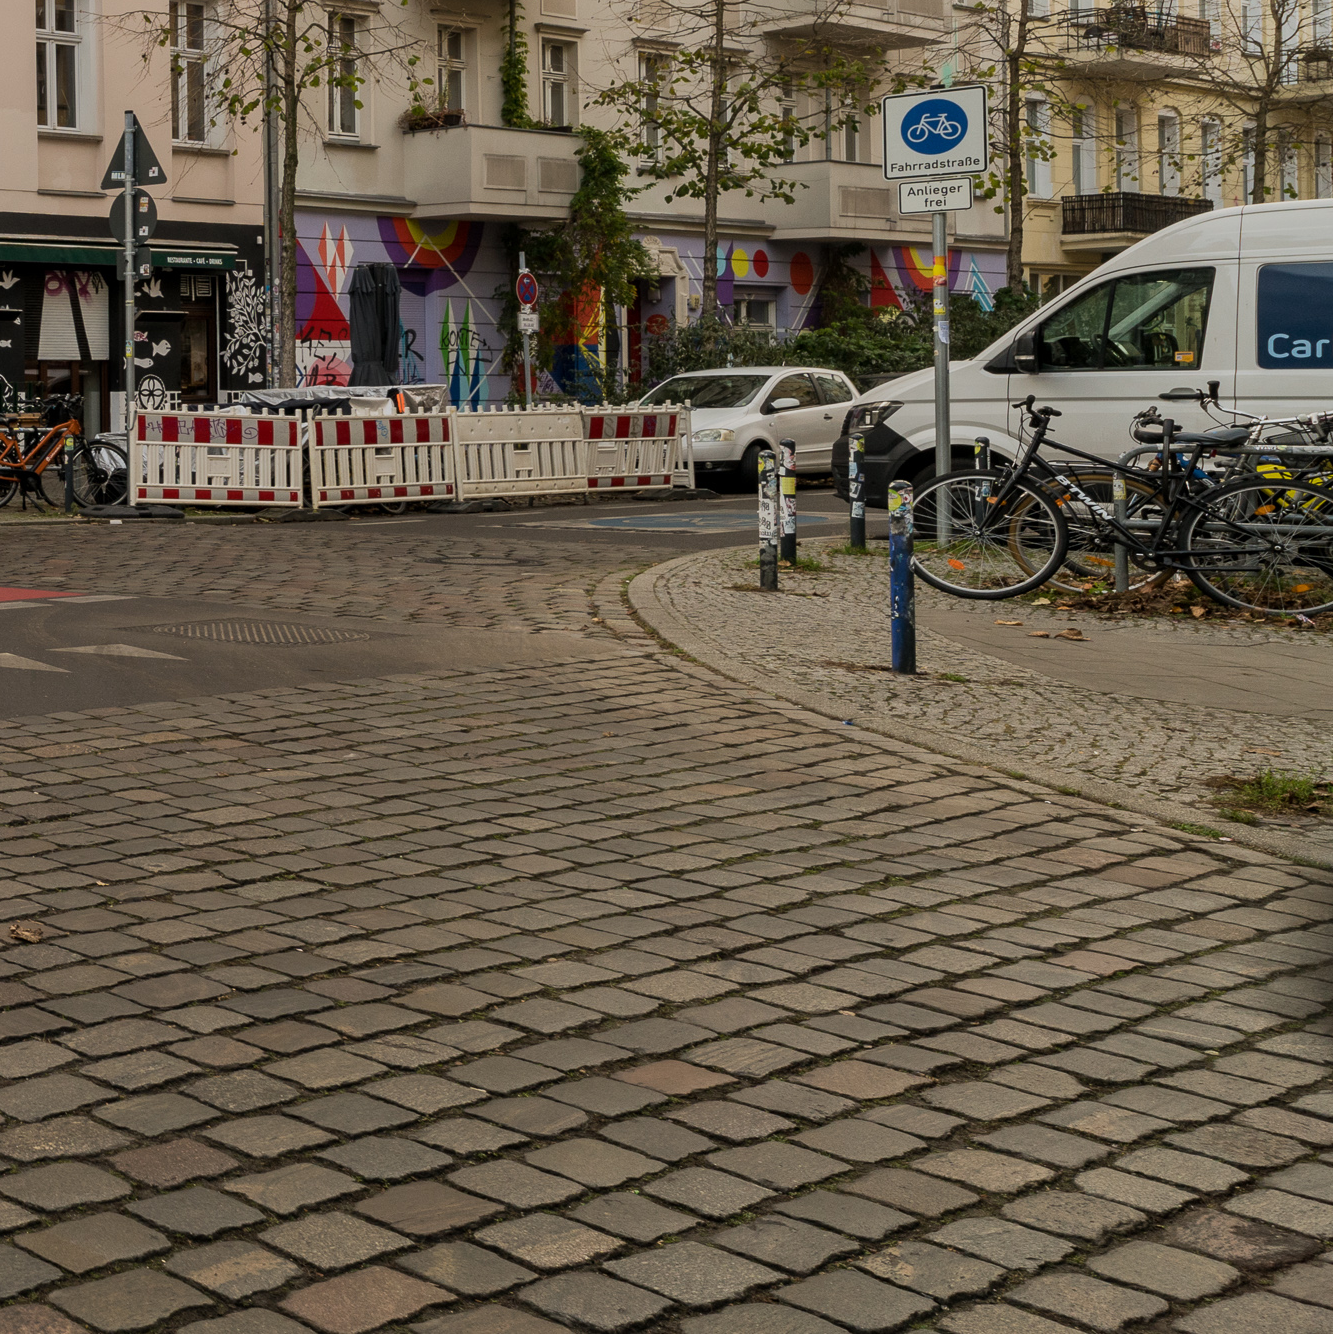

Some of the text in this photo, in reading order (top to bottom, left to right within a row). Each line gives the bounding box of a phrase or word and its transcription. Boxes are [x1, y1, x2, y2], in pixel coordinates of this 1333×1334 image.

[890, 156, 980, 173] Fahrradstraße
[907, 185, 963, 197] Anlieger
[924, 196, 946, 207] frei
[1267, 333, 1330, 359] Car
